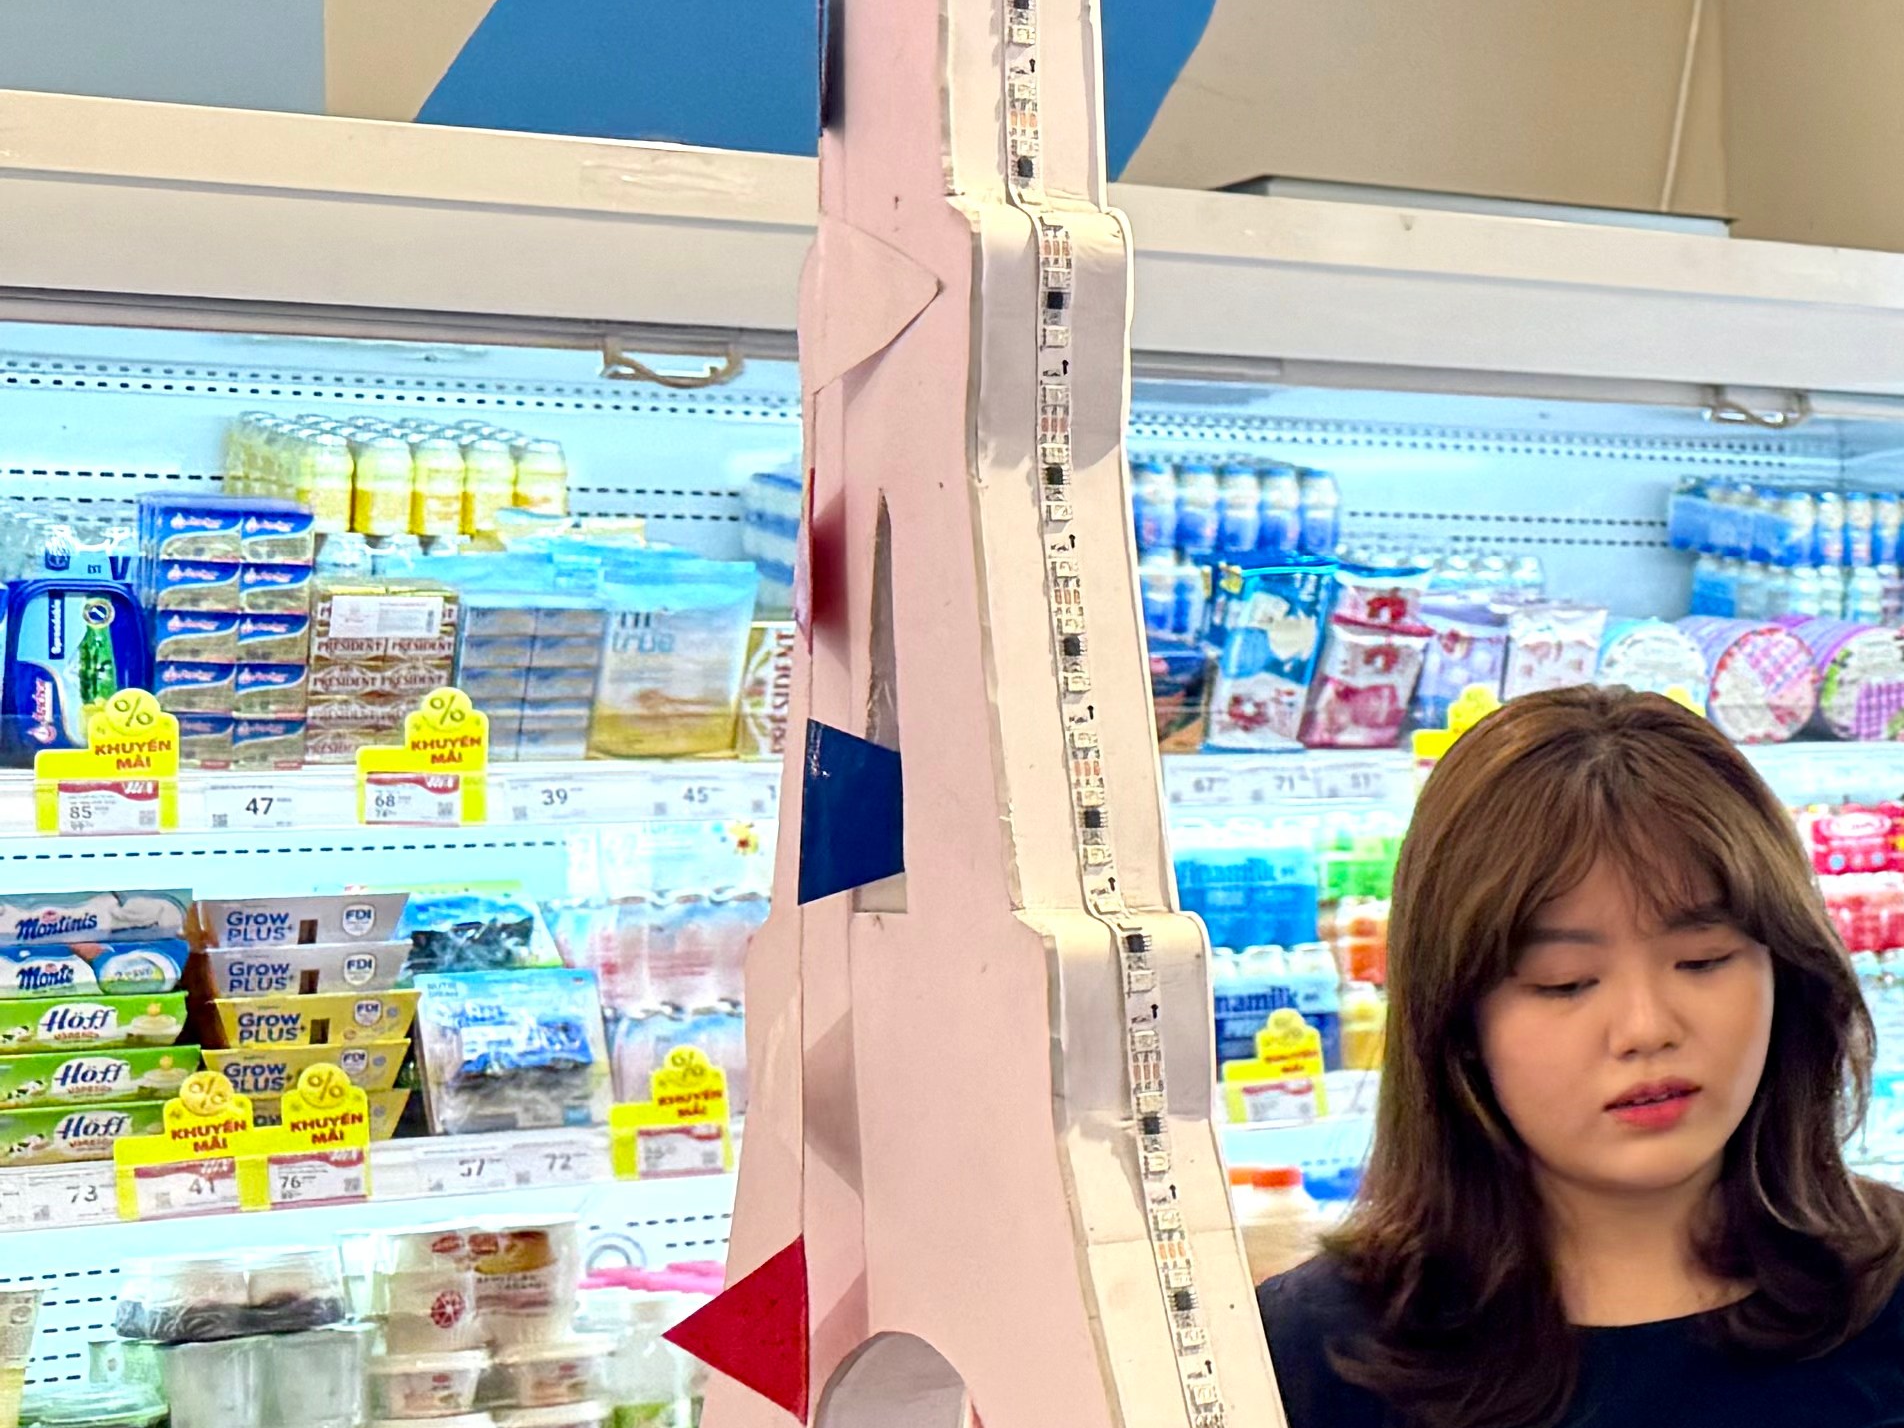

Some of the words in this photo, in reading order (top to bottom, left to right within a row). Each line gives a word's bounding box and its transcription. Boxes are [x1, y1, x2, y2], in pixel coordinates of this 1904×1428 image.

[541, 787, 569, 806] 39
[245, 797, 274, 817] 47
[226, 910, 290, 926] Grow
[345, 908, 373, 921] FDI
[228, 961, 290, 976] Grow
[346, 958, 374, 971] FDI
[356, 1001, 380, 1014] FDI
[40, 1007, 118, 1033] Höff
[238, 1012, 302, 1028] Grow
[53, 1061, 130, 1087] Höff
[223, 1062, 287, 1077] Grow
[56, 1114, 131, 1140] Höff
[171, 1118, 248, 1141] KHUYẾN
[290, 1111, 364, 1133] KHUYẾN
[66, 1185, 99, 1205] 73
